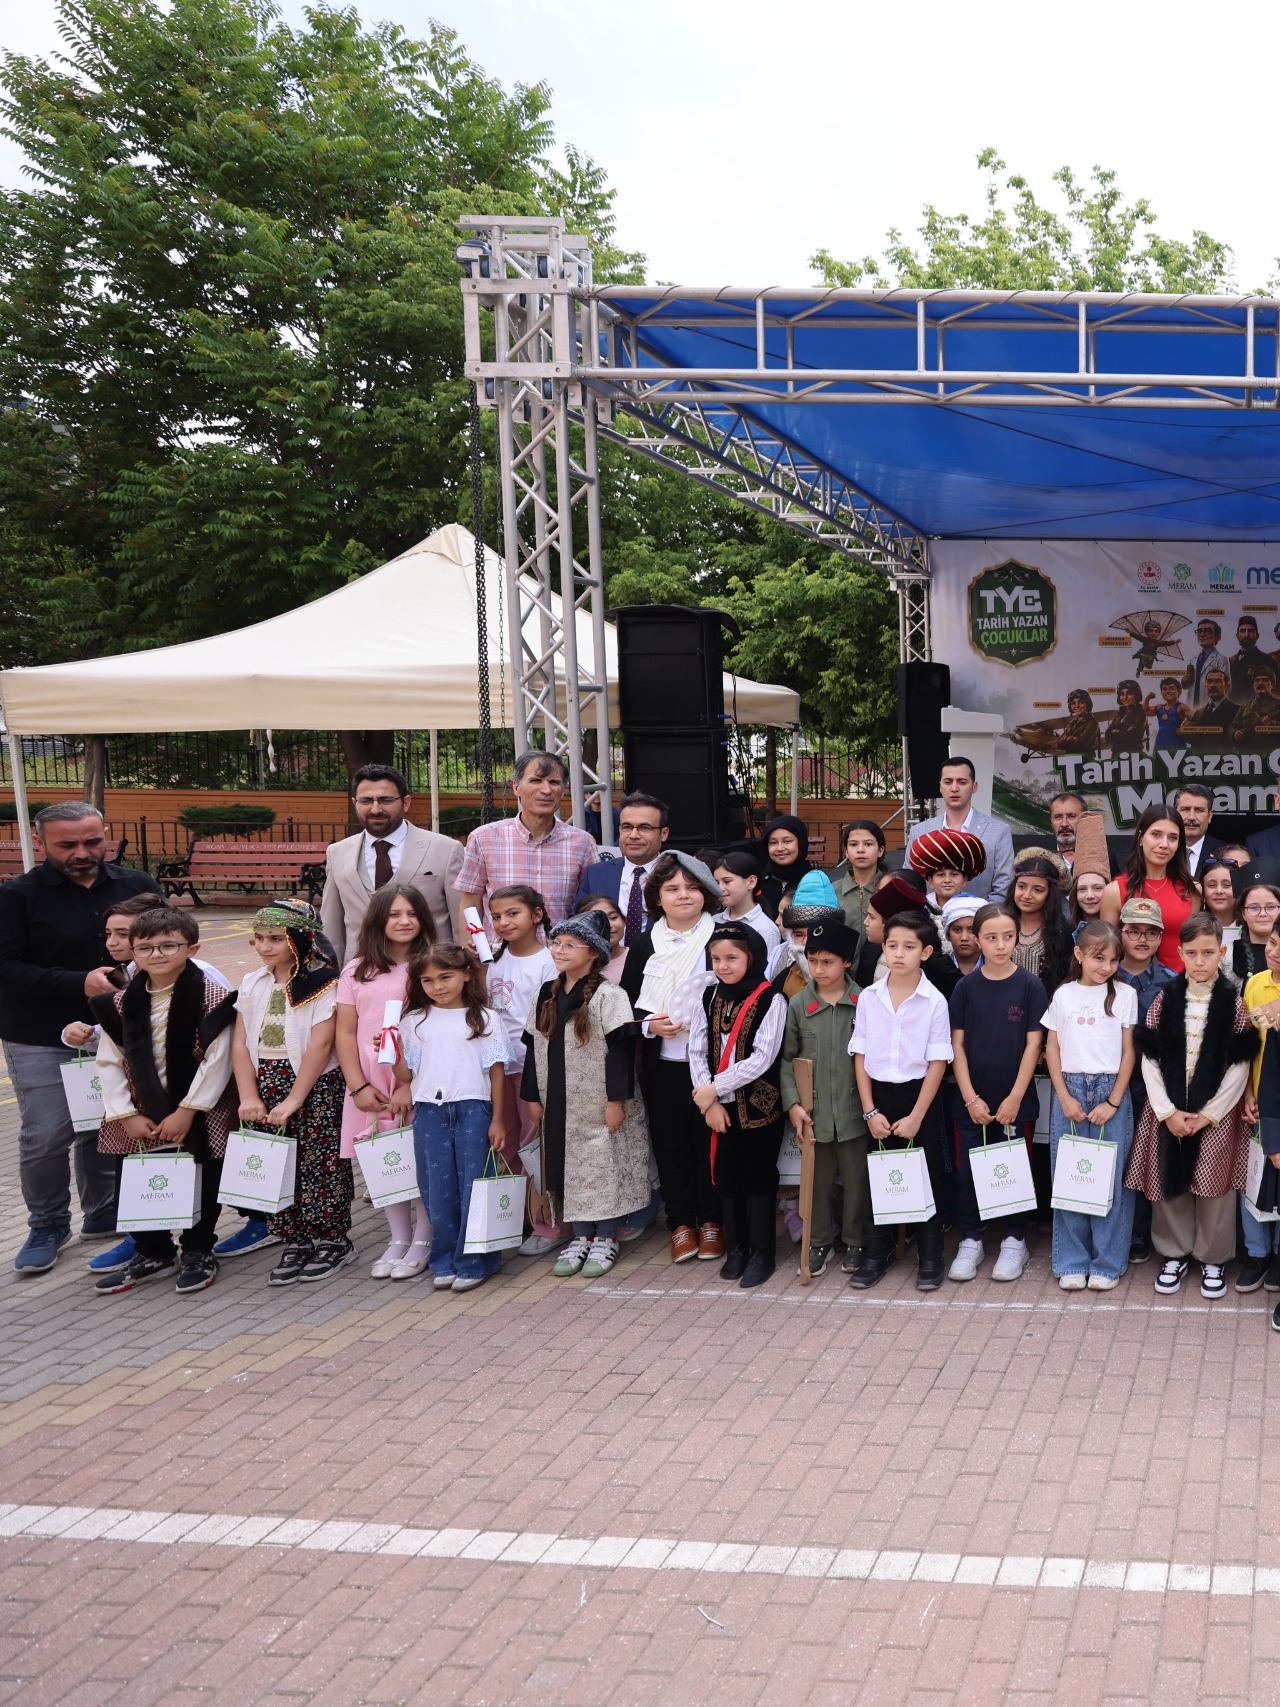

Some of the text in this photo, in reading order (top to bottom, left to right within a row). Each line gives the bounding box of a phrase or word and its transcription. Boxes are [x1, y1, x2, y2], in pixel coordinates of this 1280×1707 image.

[1167, 582, 1197, 590] MERAM
[976, 614, 1048, 630] TARİH YAZAN
[980, 628, 1049, 649] ÇOCUKLAR
[1057, 751, 1153, 787] Tarih
[1158, 749, 1263, 779] Yazan
[238, 1170, 266, 1181] MERAM
[381, 1164, 411, 1177] MERAM
[990, 1178, 1017, 1189] MERAM
[1069, 1174, 1095, 1184] MERAM
[885, 1186, 910, 1194] MERAM
[140, 1192, 174, 1200] MERAM
